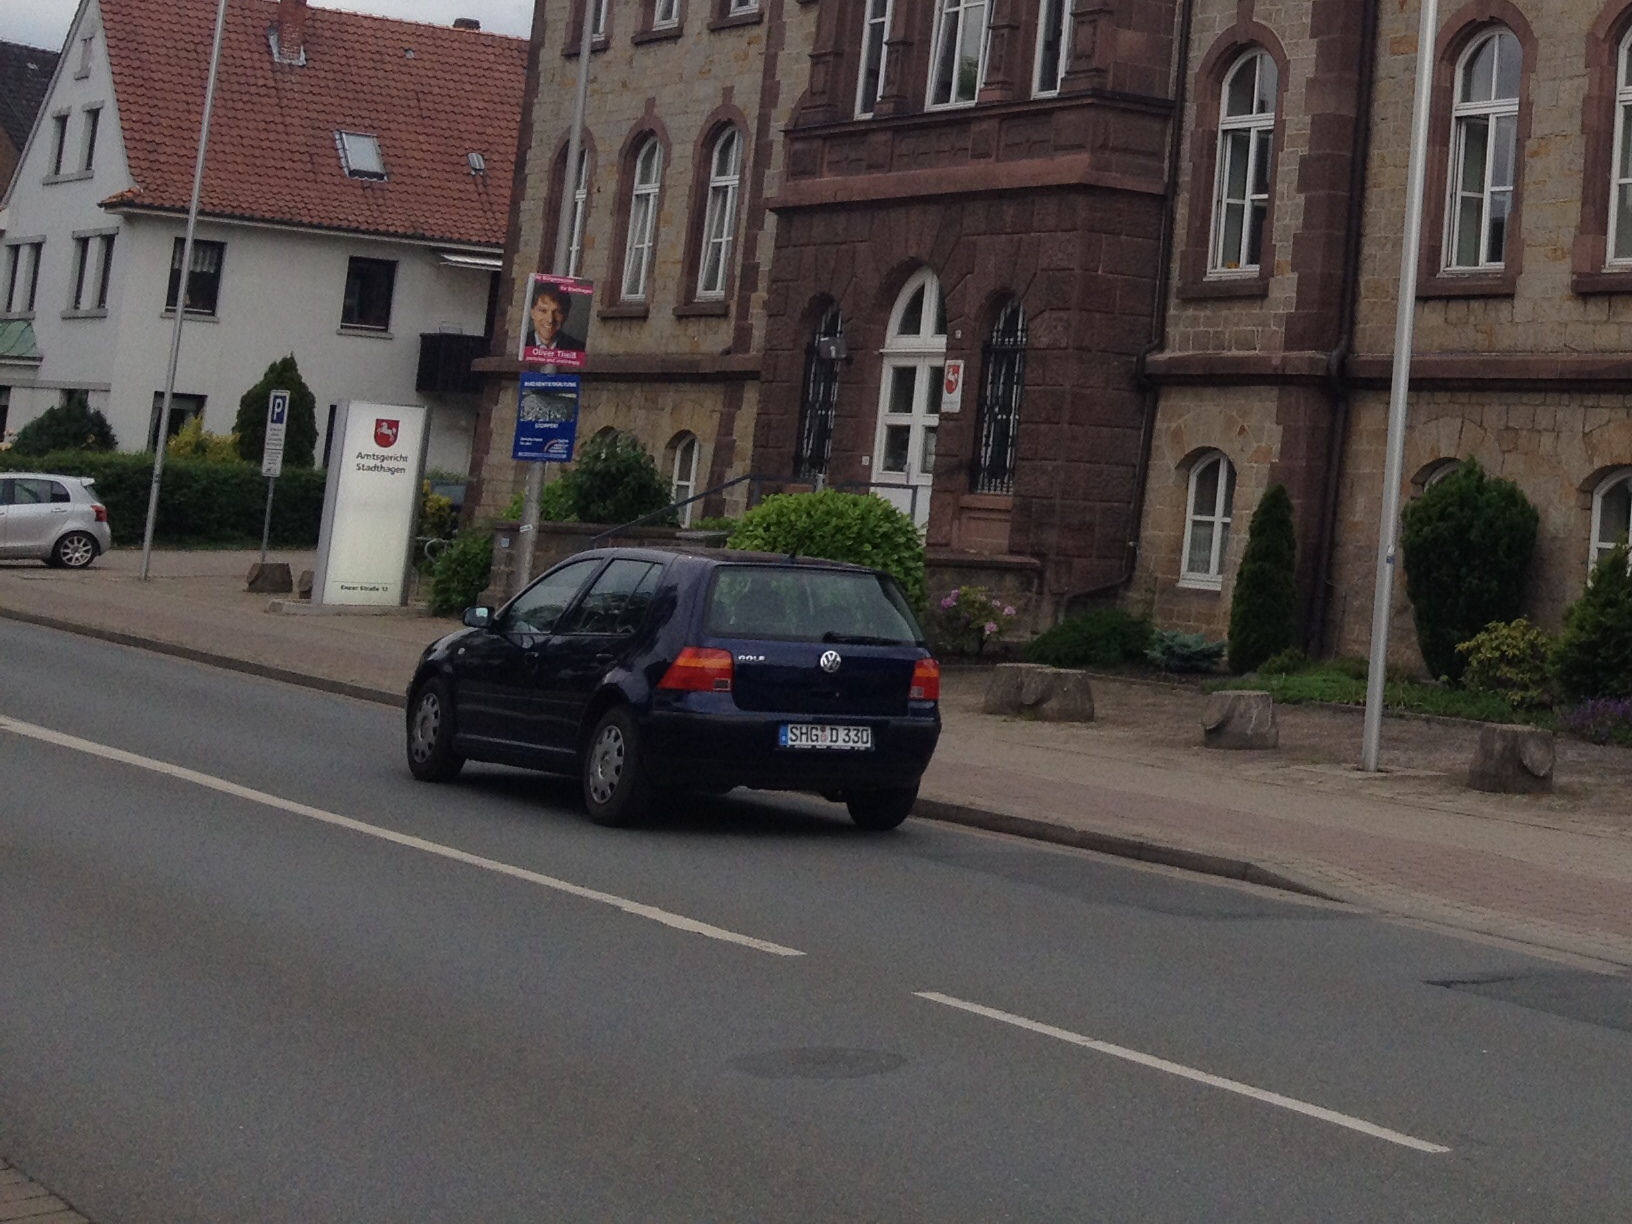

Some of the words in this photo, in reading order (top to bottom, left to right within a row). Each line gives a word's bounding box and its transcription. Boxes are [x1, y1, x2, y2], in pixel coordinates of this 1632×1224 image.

[274, 398, 283, 421] P
[355, 451, 408, 463] Amtsgericht
[355, 462, 406, 475] Stadthagen
[789, 725, 819, 743] SHG
[829, 727, 839, 744] D
[842, 727, 870, 745] 330
